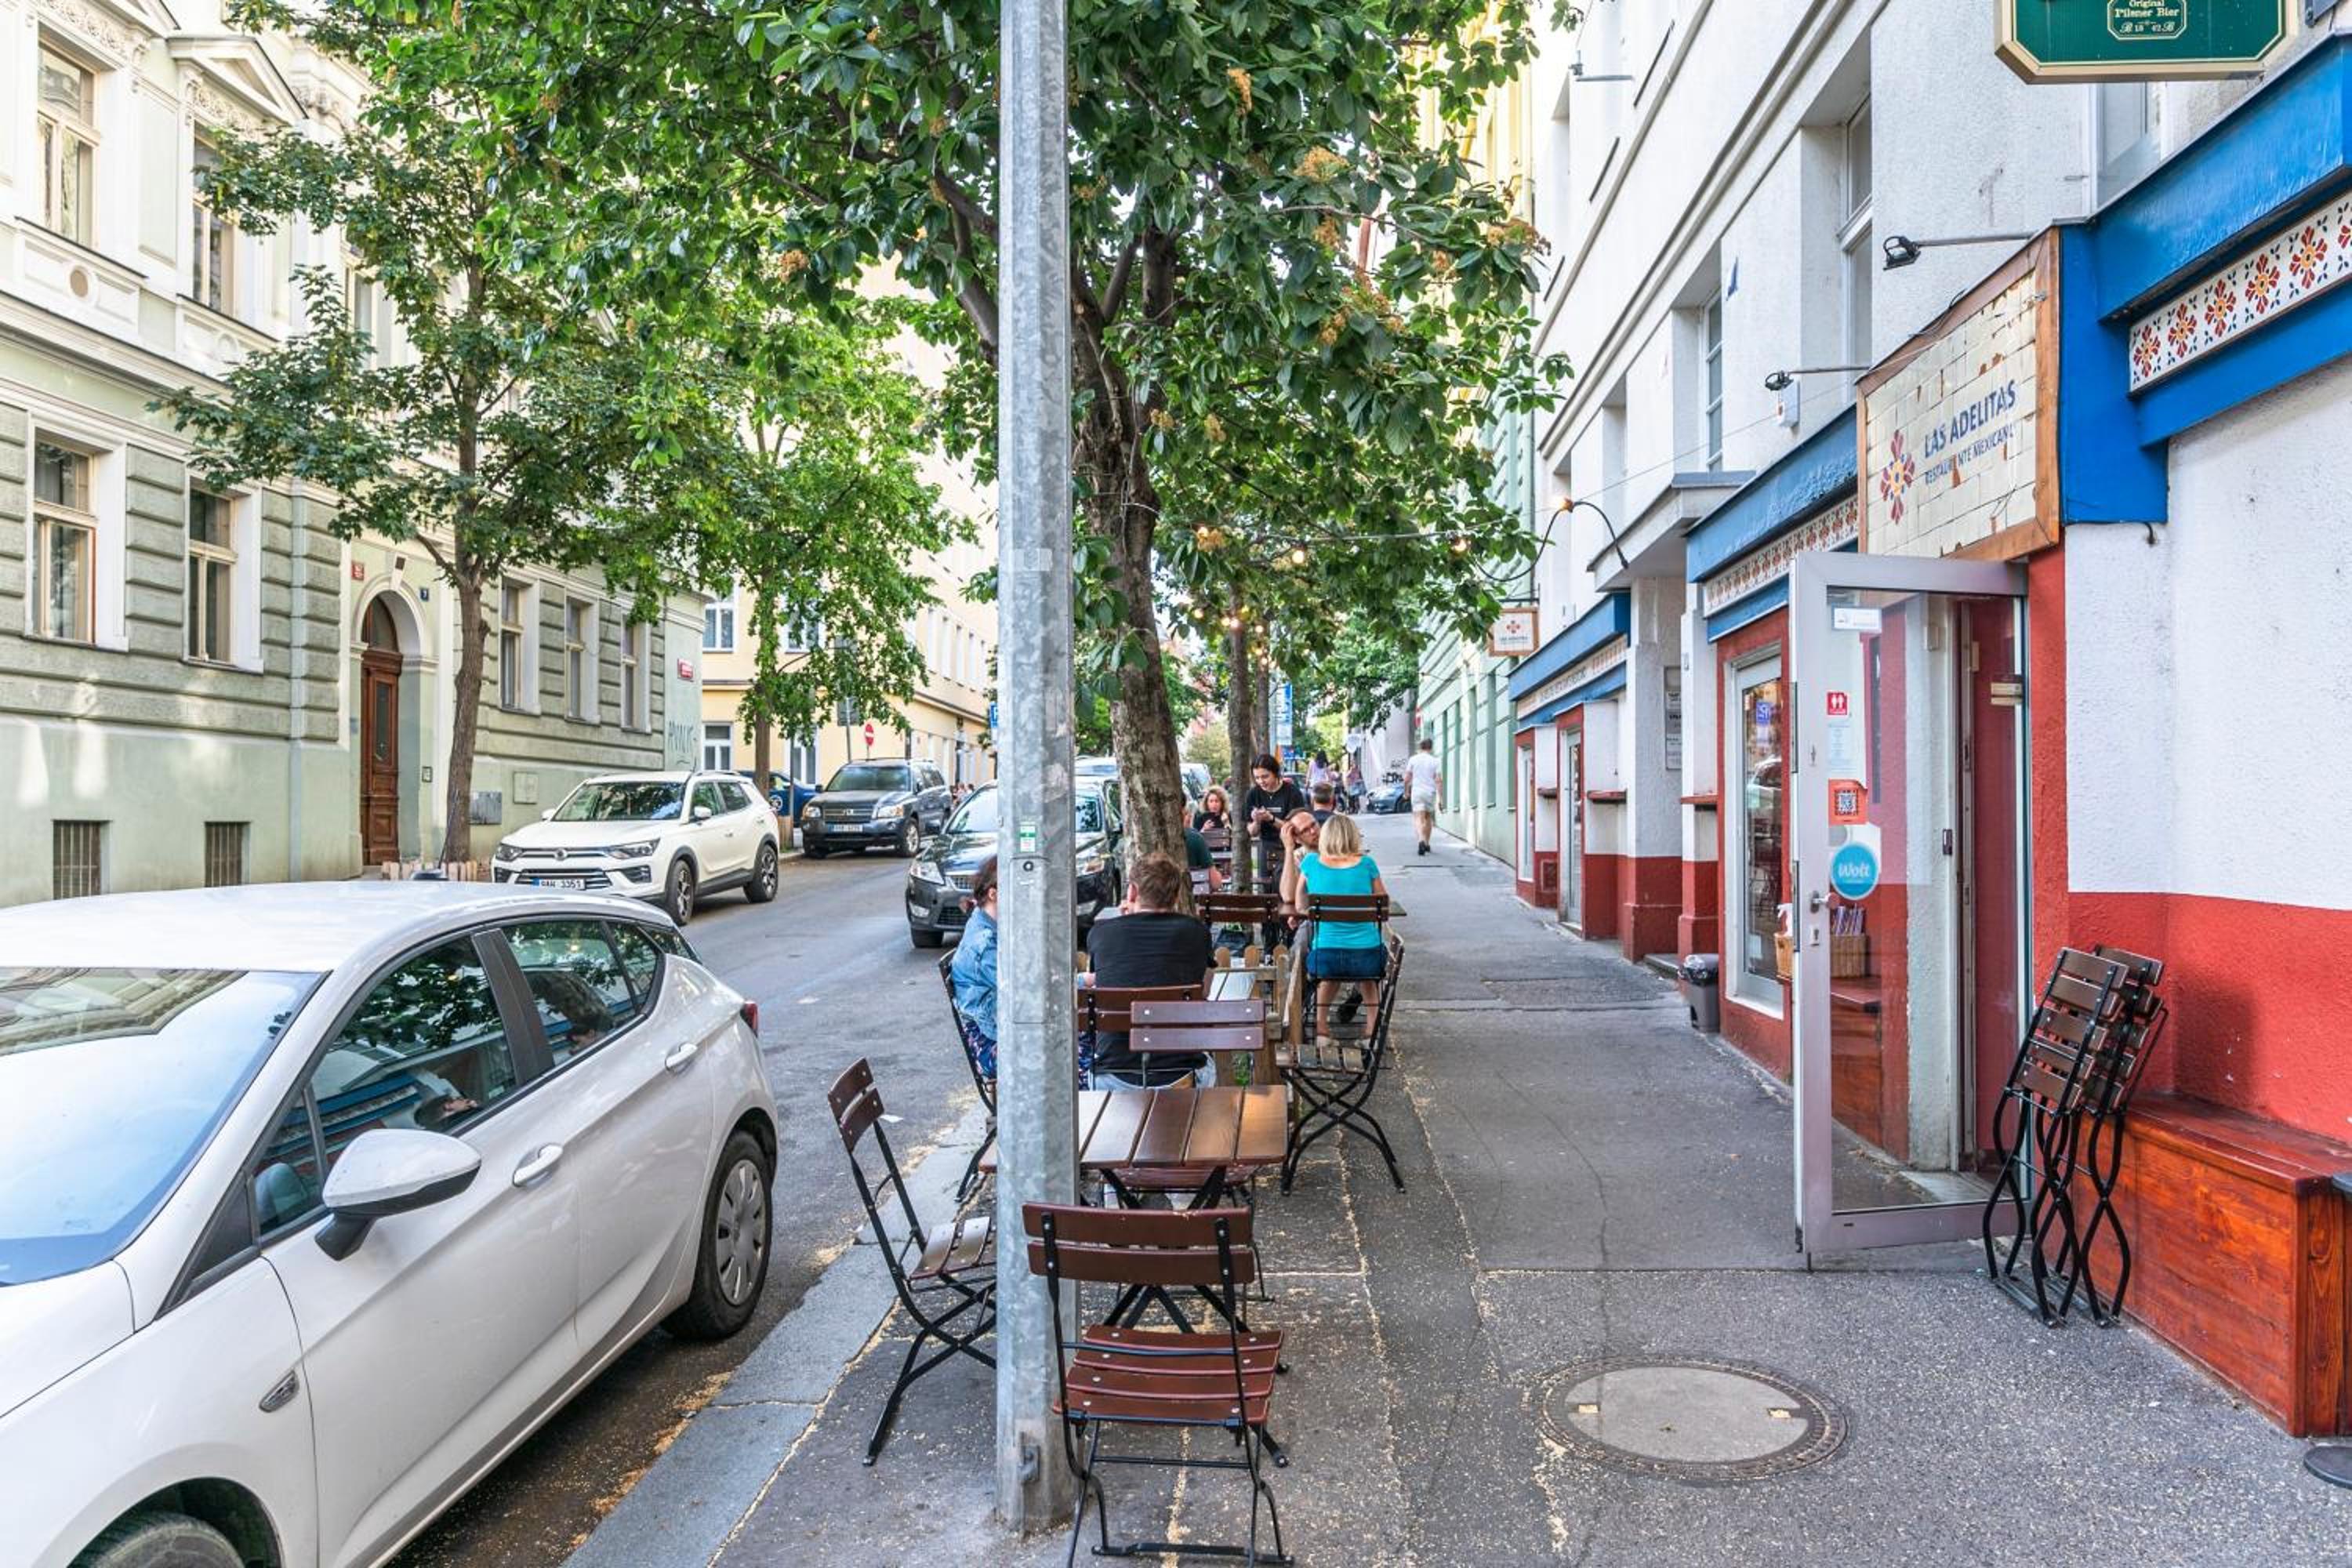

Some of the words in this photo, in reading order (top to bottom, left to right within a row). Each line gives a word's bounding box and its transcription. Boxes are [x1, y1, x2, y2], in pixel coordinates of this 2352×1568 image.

[2129, 0, 2165, 9] Original
[2156, 7, 2180, 16] Bier
[1925, 423, 1947, 459] LAS
[1950, 379, 2016, 445] ADELITAS
[1838, 862, 1871, 878] Wolt
